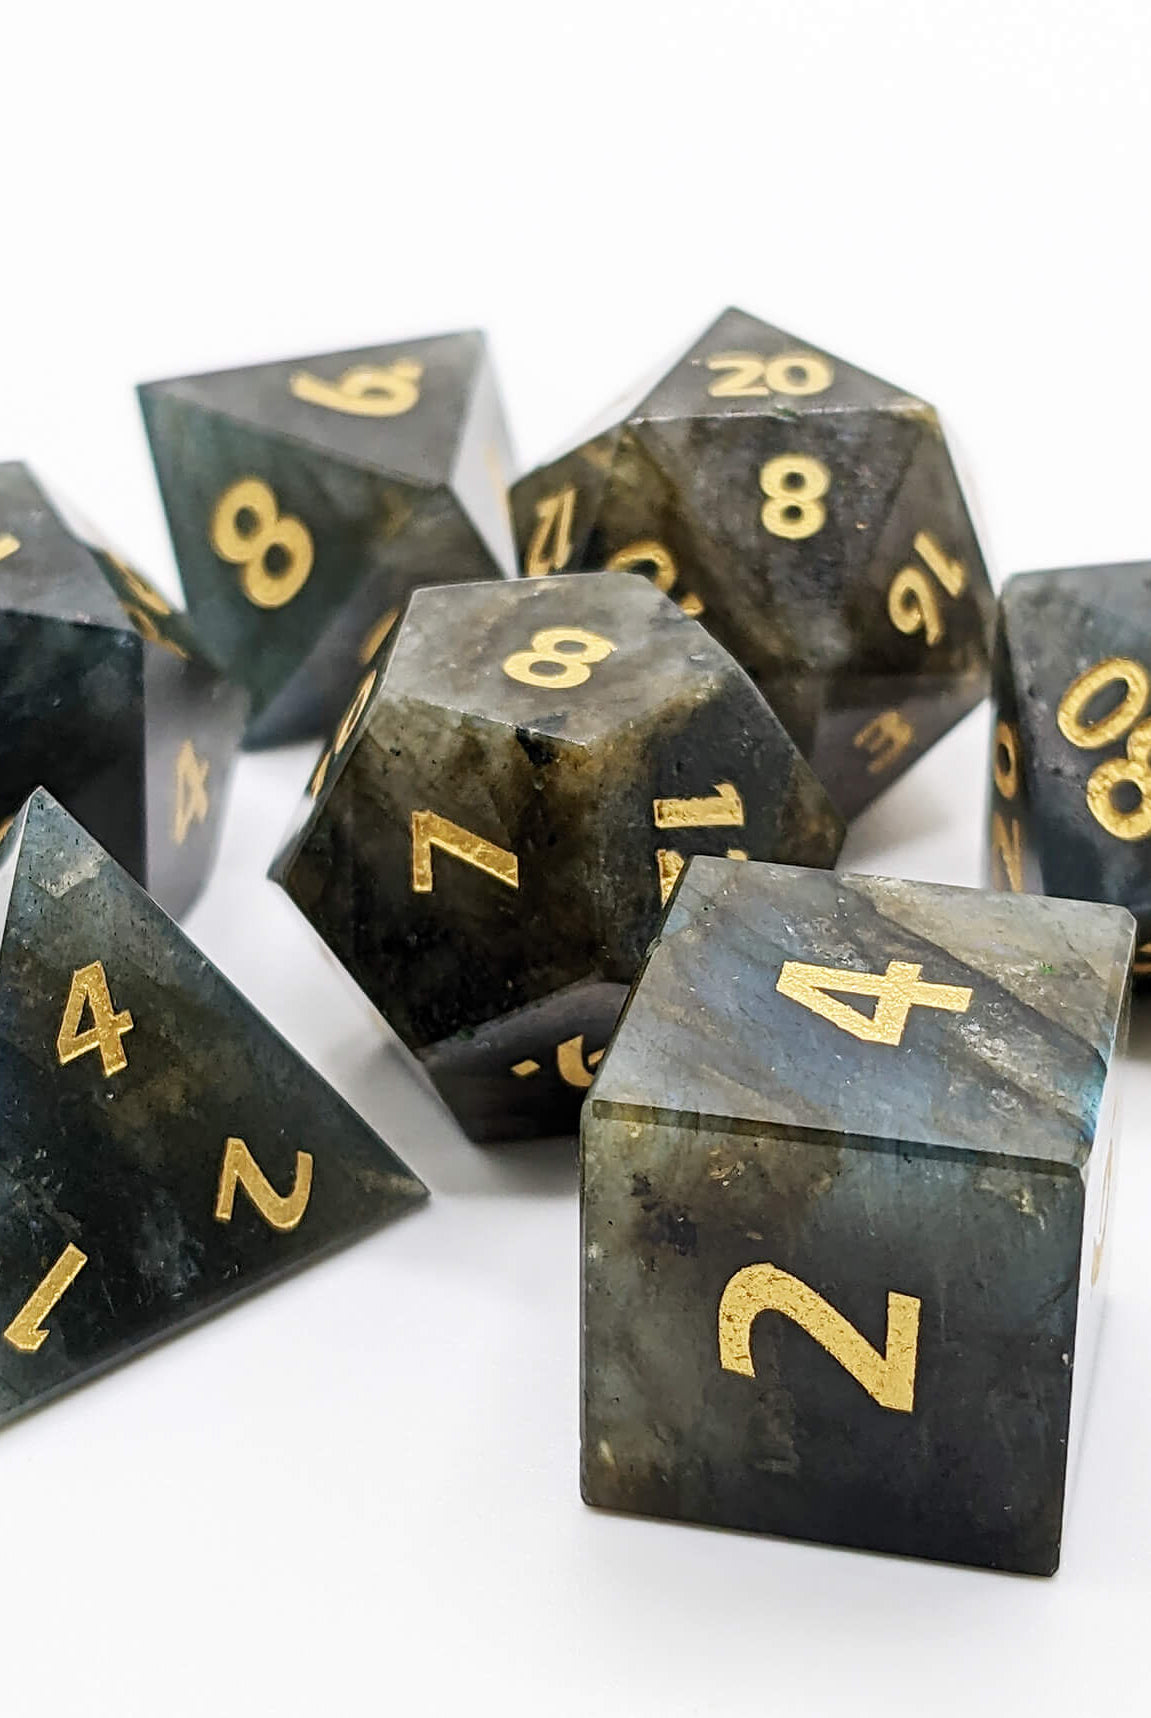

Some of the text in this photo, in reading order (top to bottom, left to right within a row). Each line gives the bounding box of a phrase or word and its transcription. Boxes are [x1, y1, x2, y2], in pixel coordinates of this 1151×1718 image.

[707, 351, 834, 398] 20
[210, 476, 315, 609] 8
[757, 451, 831, 542] 8
[503, 625, 616, 690] 8
[409, 808, 520, 893] 7
[55, 960, 135, 1078] 4
[776, 959, 973, 1046] 4
[214, 1136, 314, 1231] 2
[3, 1242, 88, 1354] 1
[718, 1261, 922, 1414] 2
